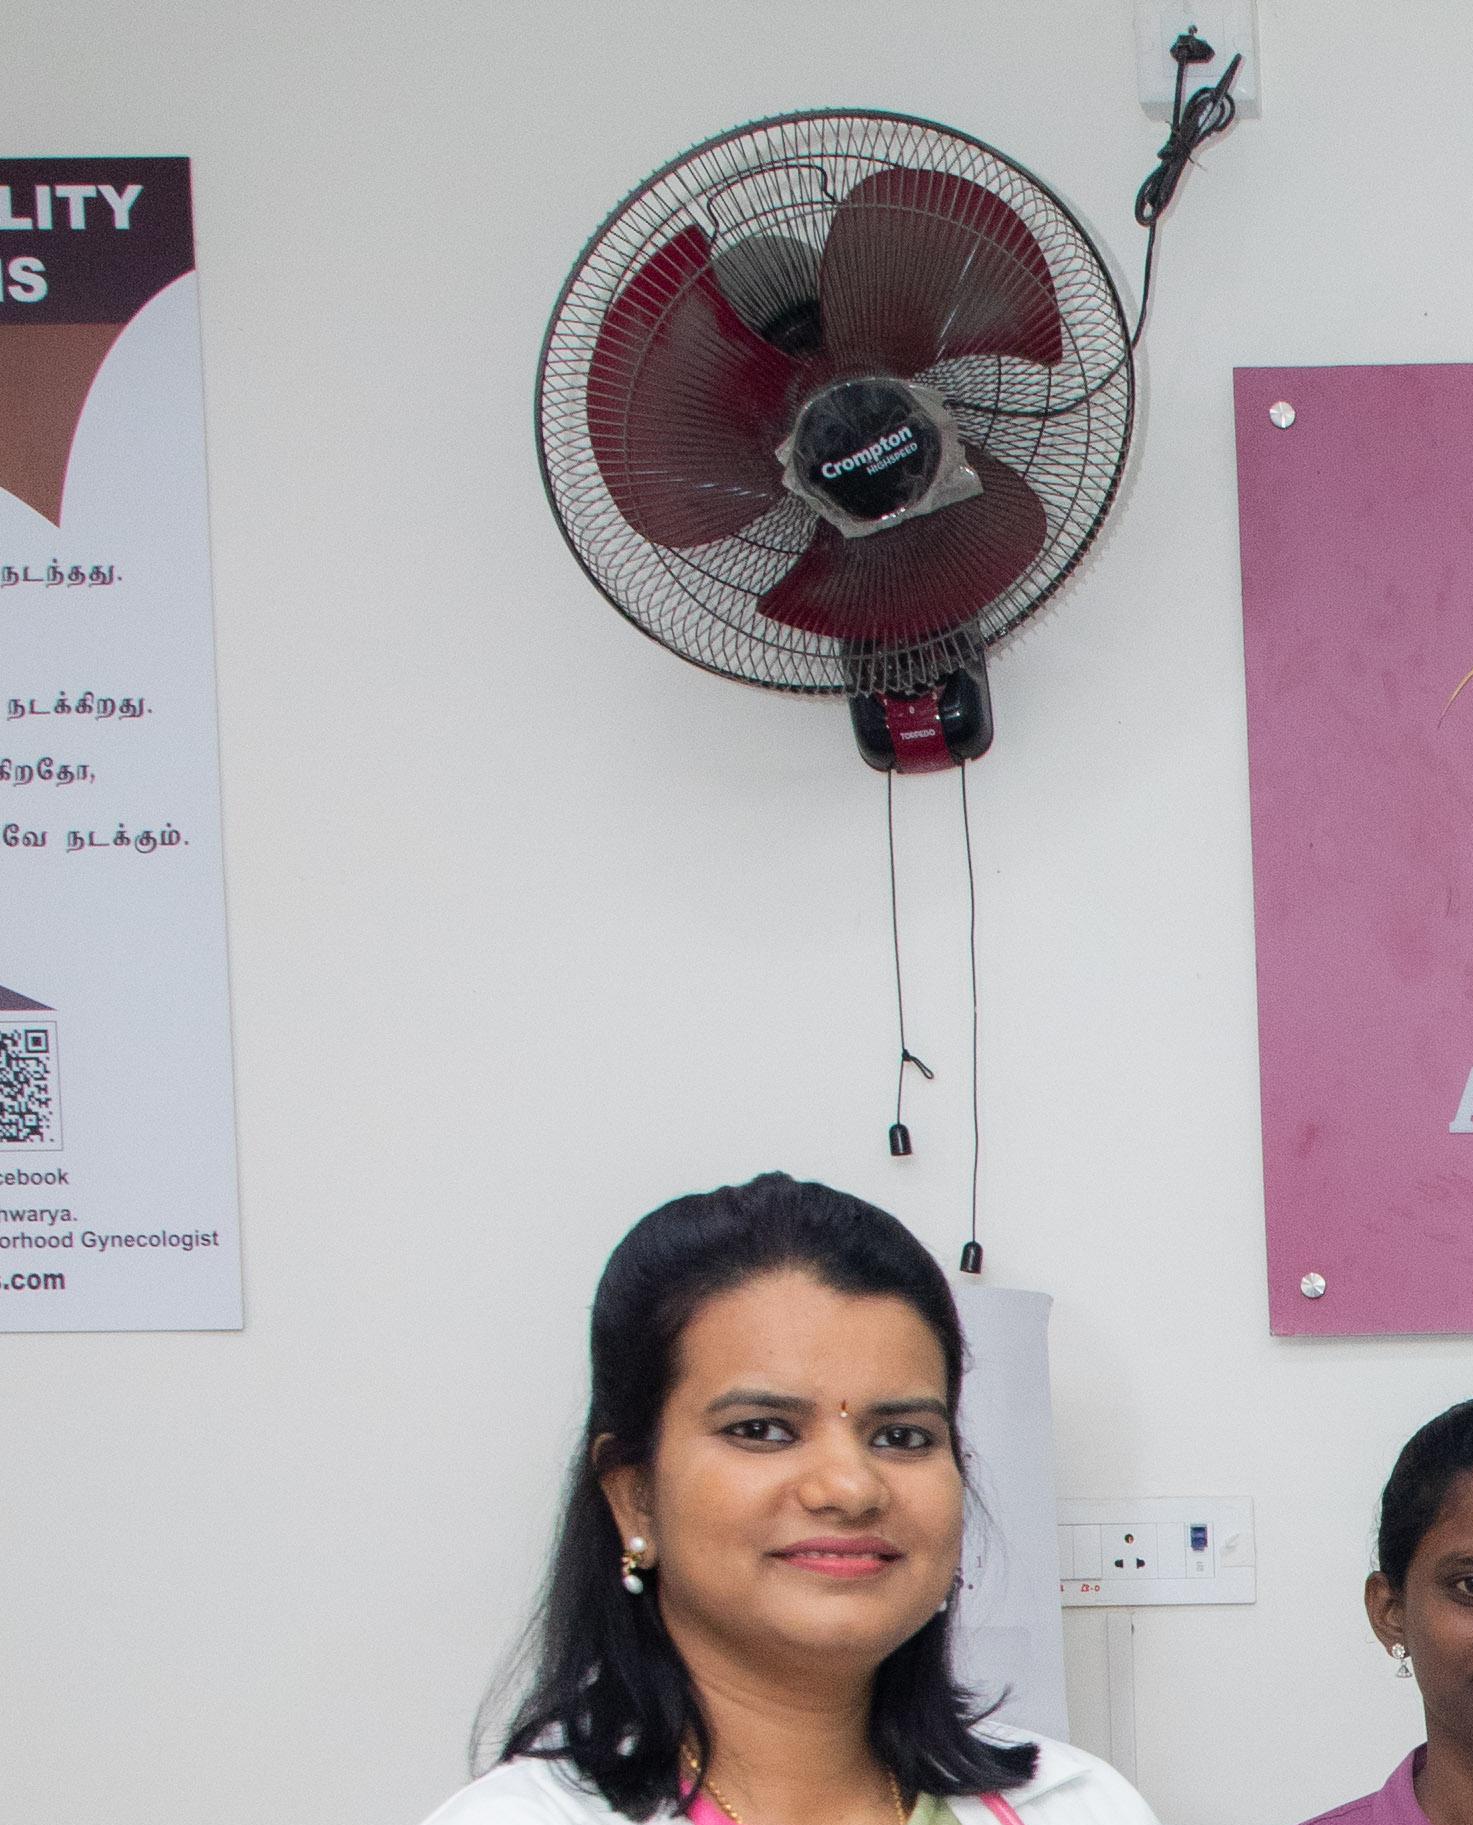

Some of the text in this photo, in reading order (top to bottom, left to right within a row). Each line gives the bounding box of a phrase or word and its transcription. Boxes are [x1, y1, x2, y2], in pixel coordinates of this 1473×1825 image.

[0, 256, 49, 303] S
[821, 425, 913, 479] Crompton
[866, 442, 919, 476] HIGHSPEED
[0, 1168, 69, 1186] ebook
[81, 1230, 220, 1251] Gynecologist
[0, 1272, 66, 1291] .com
